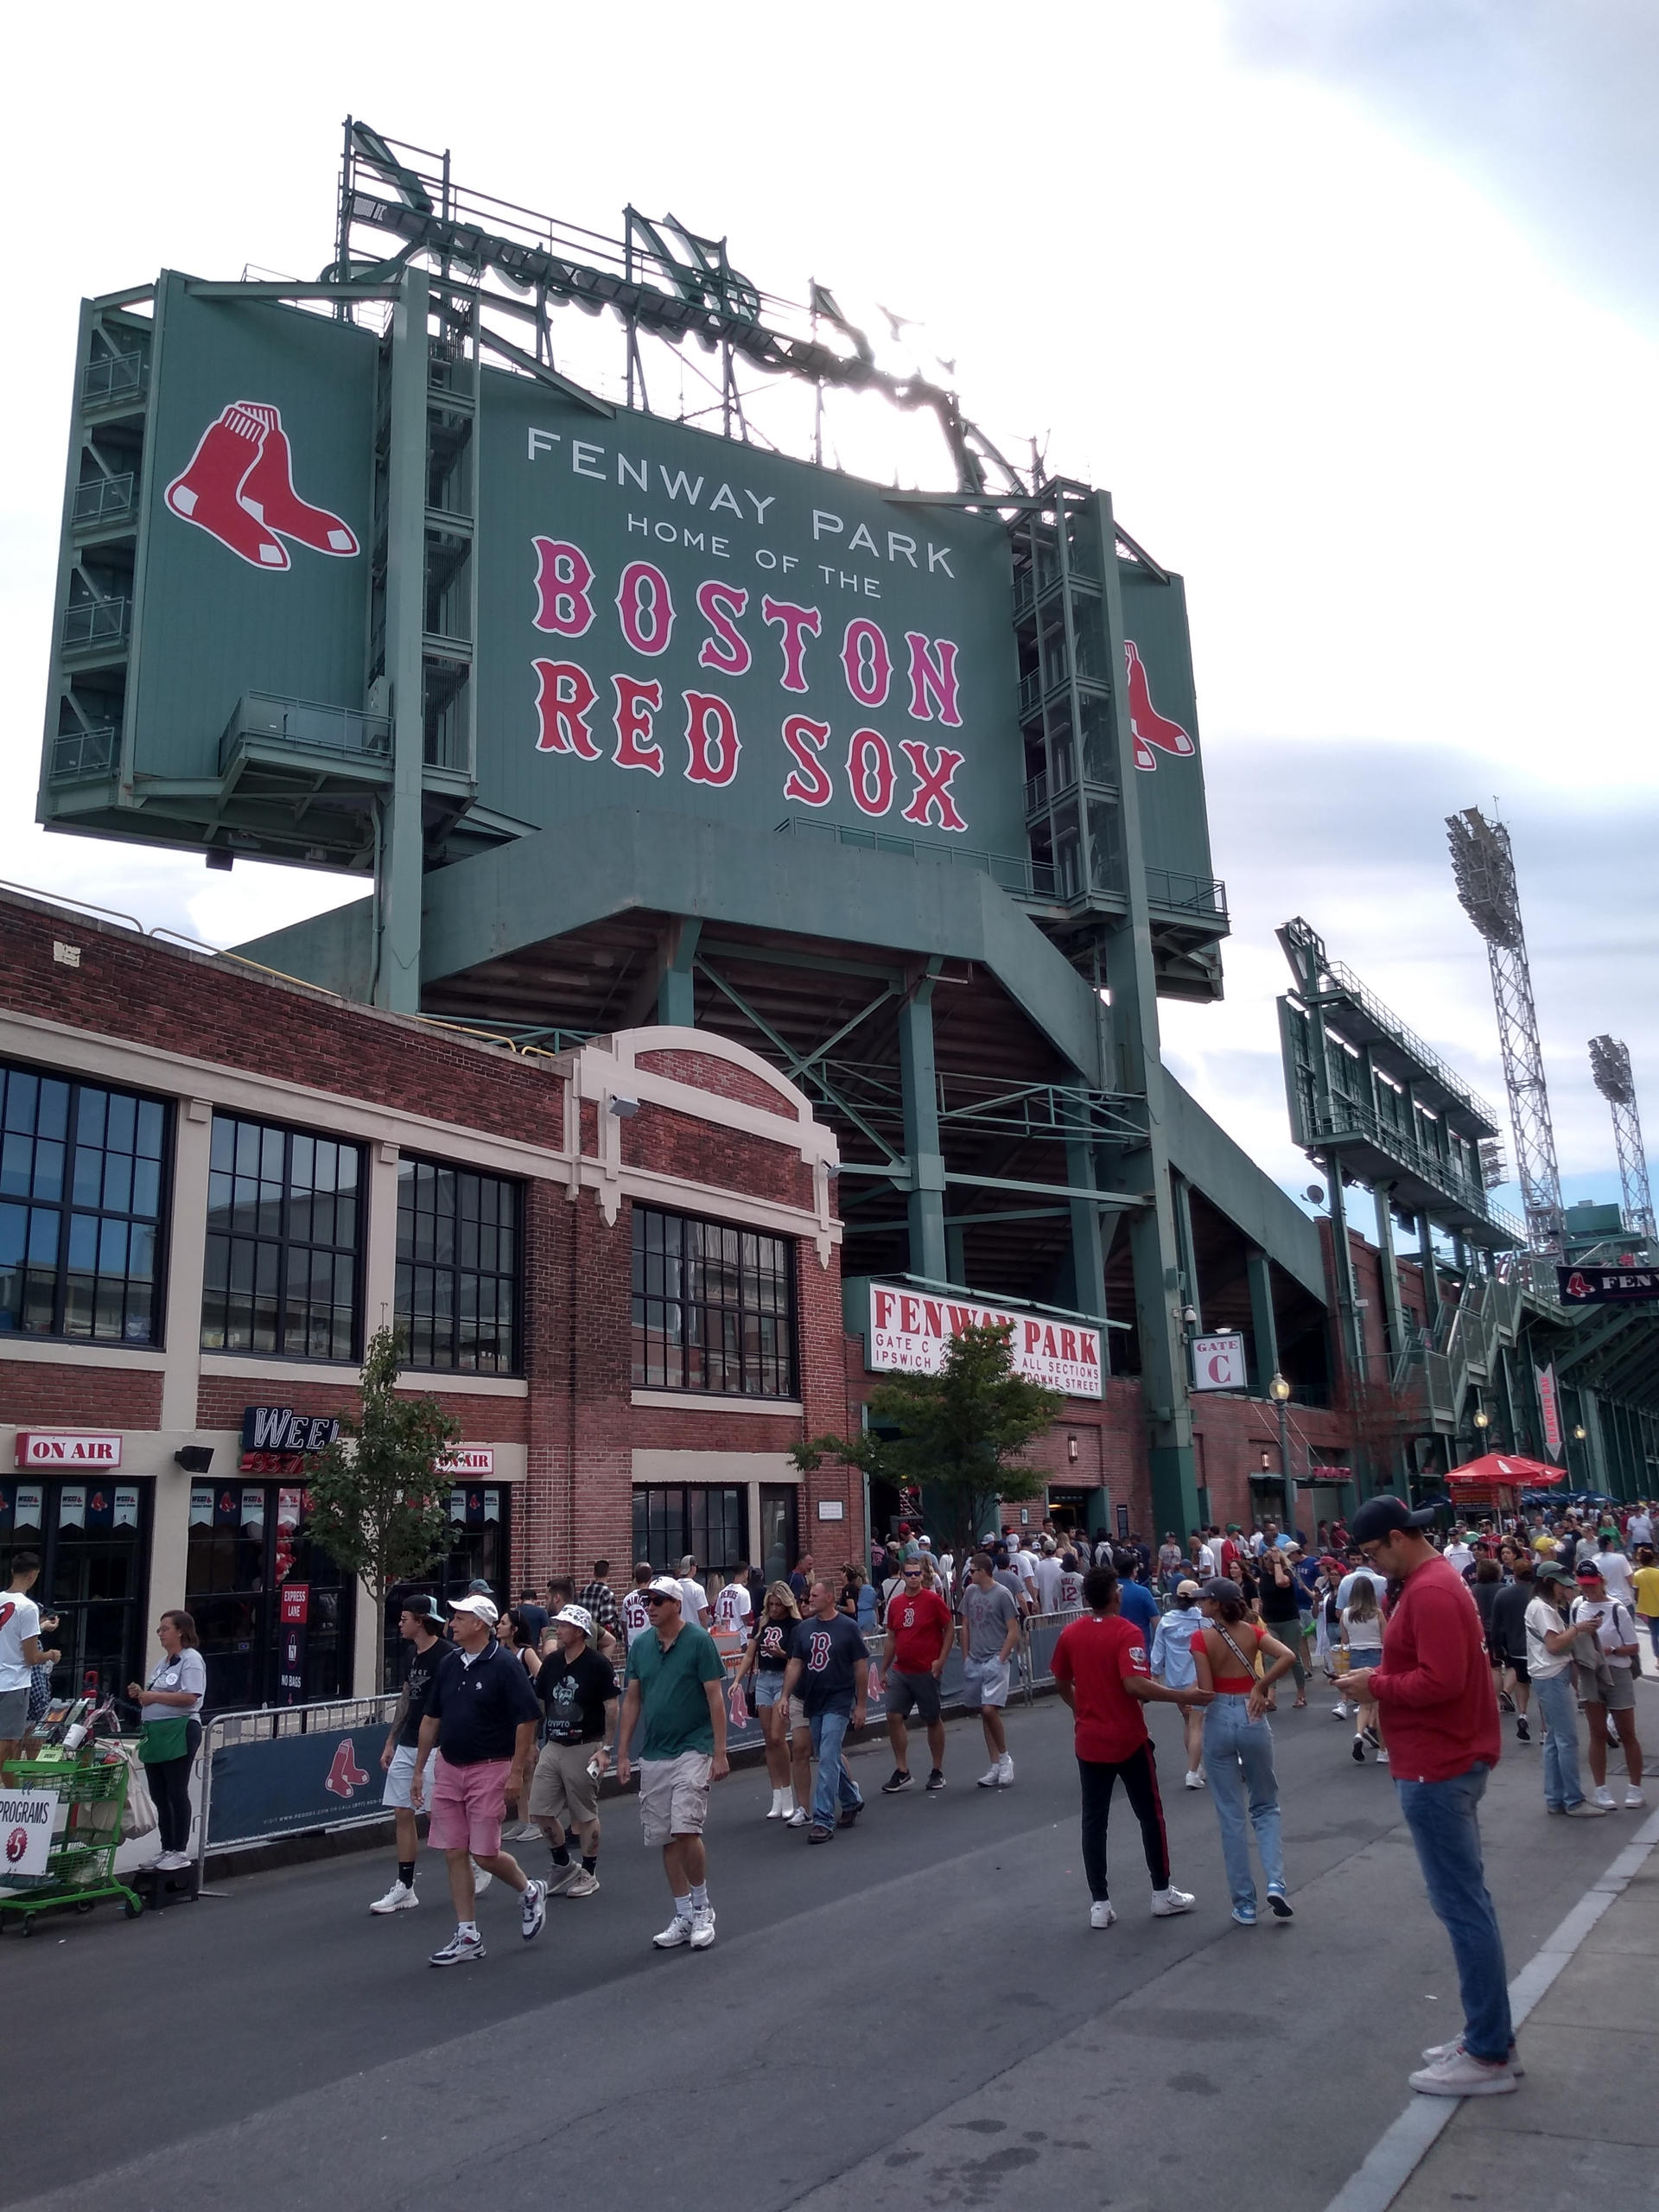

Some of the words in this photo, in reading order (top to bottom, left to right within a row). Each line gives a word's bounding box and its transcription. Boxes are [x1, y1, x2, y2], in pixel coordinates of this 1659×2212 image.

[527, 426, 776, 525] FENWAY
[812, 508, 955, 579] PARK
[627, 512, 730, 559] HOME
[755, 549, 799, 574] OF
[818, 564, 881, 599] THE
[531, 535, 963, 728] BOSTON
[531, 658, 743, 788] RED
[781, 714, 969, 833] SOX
[875, 1333, 912, 1351] GATE
[922, 1340, 929, 1353] C
[1023, 1320, 1098, 1365] PARK
[1196, 1340, 1238, 1352] GATE
[876, 1350, 931, 1369] IPSWICH
[1022, 1357, 1041, 1370] ALL
[1048, 1362, 1099, 1380] SECTIONS
[1208, 1355, 1230, 1383] C
[1065, 1378, 1099, 1391] STREET
[33, 1441, 67, 1459] ON
[71, 1443, 113, 1459] AIR
[283, 1591, 306, 1602] EXPRESS
[1062, 1586, 1077, 1602] 12
[288, 1605, 301, 1617] LANE
[722, 1600, 734, 1618] 11
[807, 1631, 832, 1672] B
[281, 1675, 289, 1687] NO
[289, 1675, 302, 1688] BAGS
[0, 1801, 49, 1824] PROGRAMS
